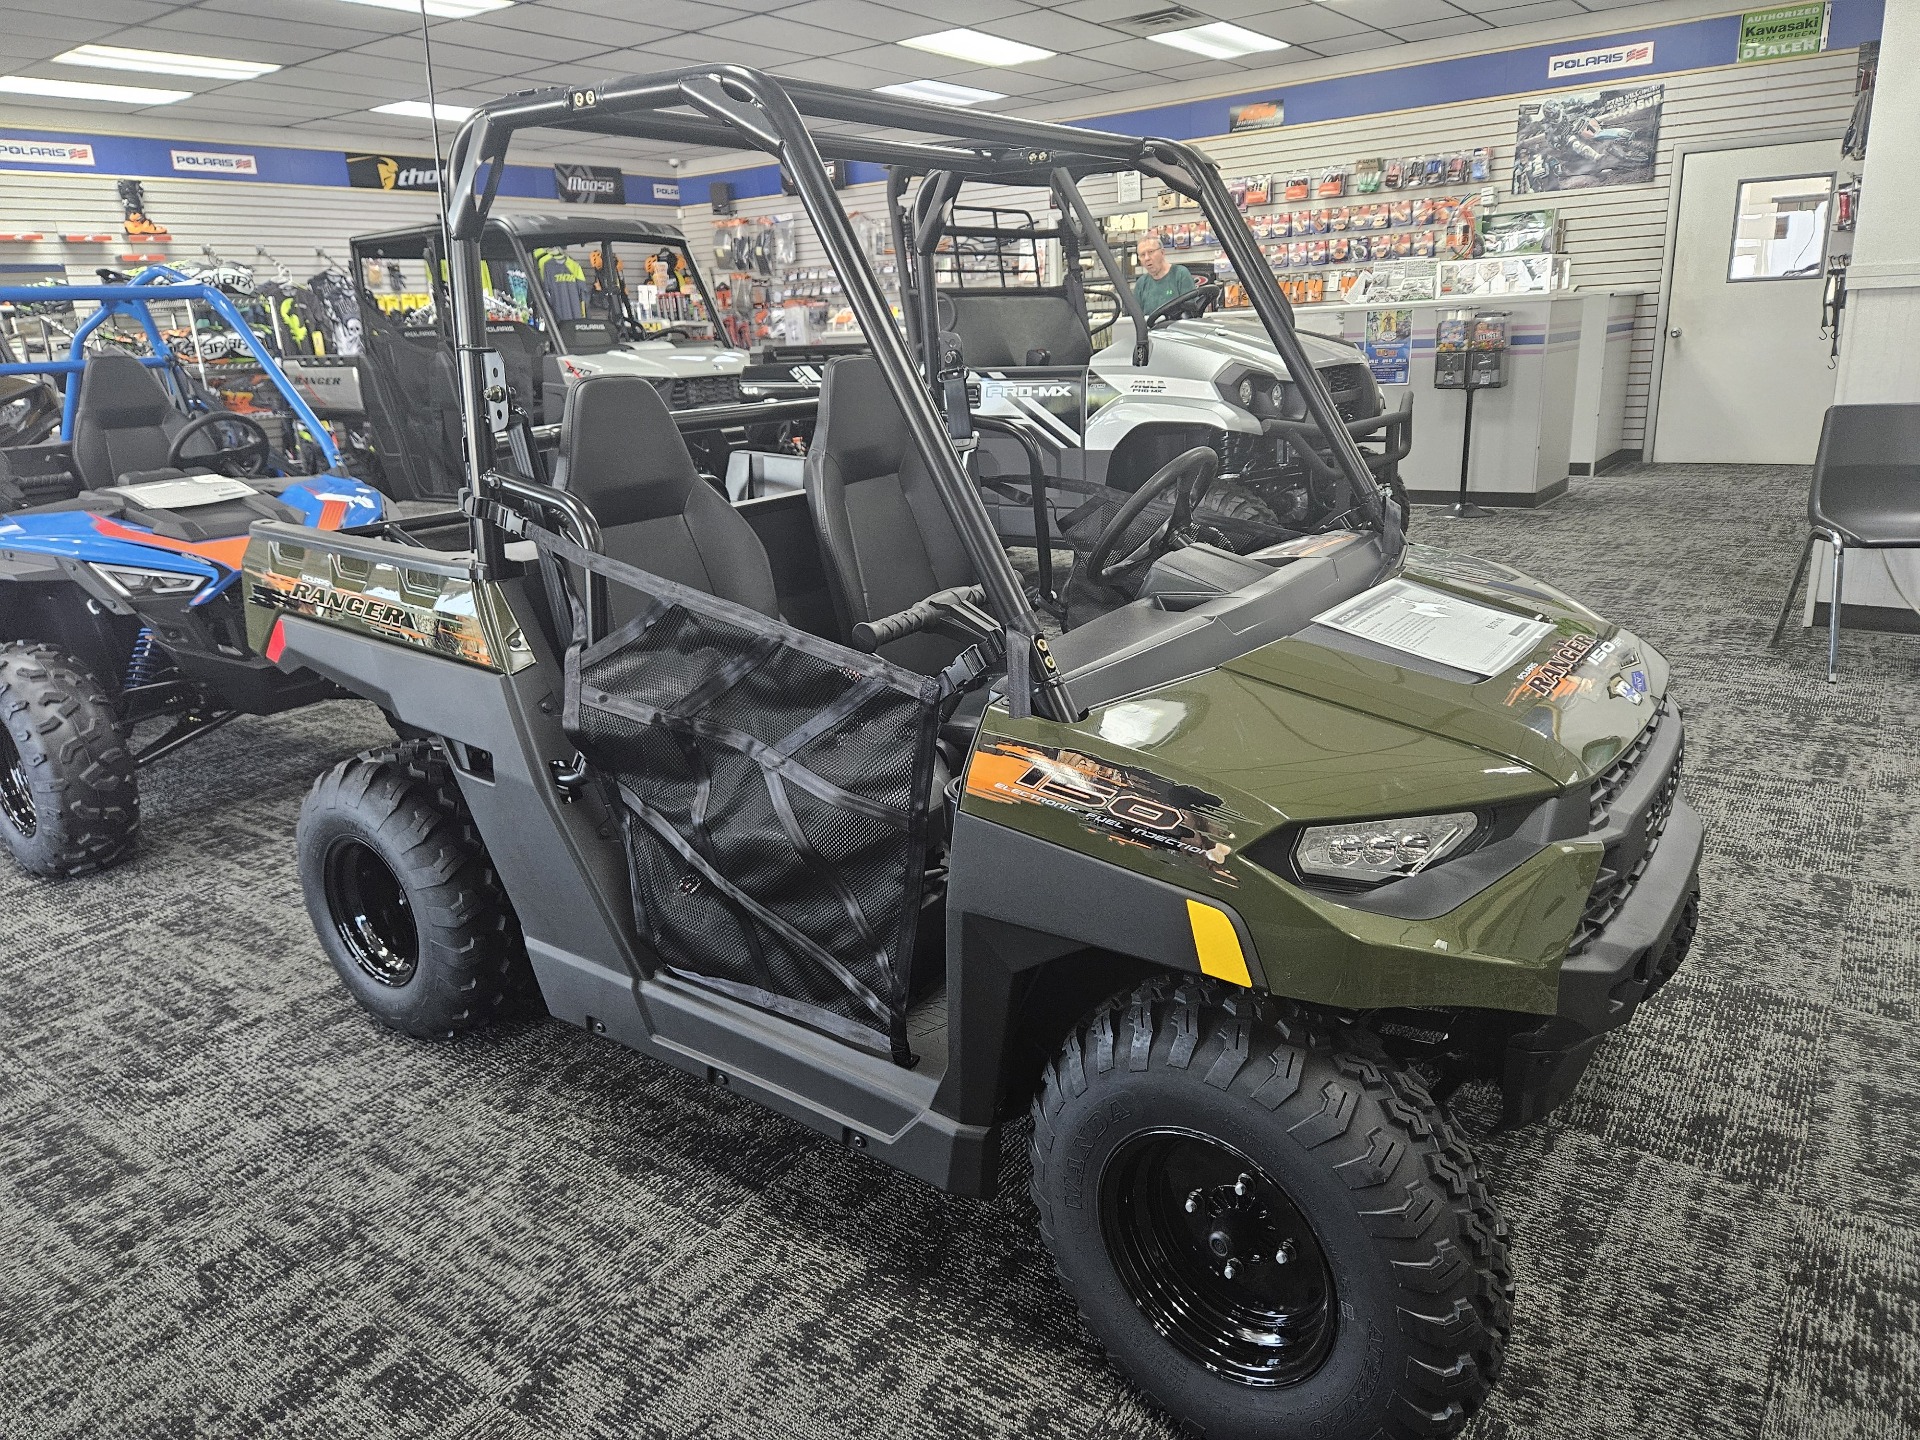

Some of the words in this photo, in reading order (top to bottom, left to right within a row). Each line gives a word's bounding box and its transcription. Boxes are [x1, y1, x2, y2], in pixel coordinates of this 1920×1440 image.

[1747, 6, 1820, 24] AUTHORIZED
[1745, 16, 1819, 37] Kawasaki
[1778, 29, 1817, 40] GREEN
[1743, 38, 1816, 59] DEALER
[1553, 52, 1624, 71] POLARIS
[0, 145, 66, 157] POLARIS
[176, 156, 234, 167] POLARIS
[656, 187, 679, 195] POLAR
[575, 323, 605, 331] POLARIS
[567, 365, 592, 376] 570
[295, 377, 341, 385] RANGER
[986, 386, 1073, 398] PRO-MX
[301, 574, 331, 587] POLARIS
[290, 583, 406, 627] RANGER
[1587, 641, 1616, 666] 150
[1517, 662, 1539, 680] POLARIS
[1526, 633, 1598, 697] RANGER
[996, 765, 1184, 830] 150
[994, 782, 1078, 814] ELECTRONIC
[1085, 812, 1124, 830] FUEL
[1131, 827, 1208, 856] INJECTION
